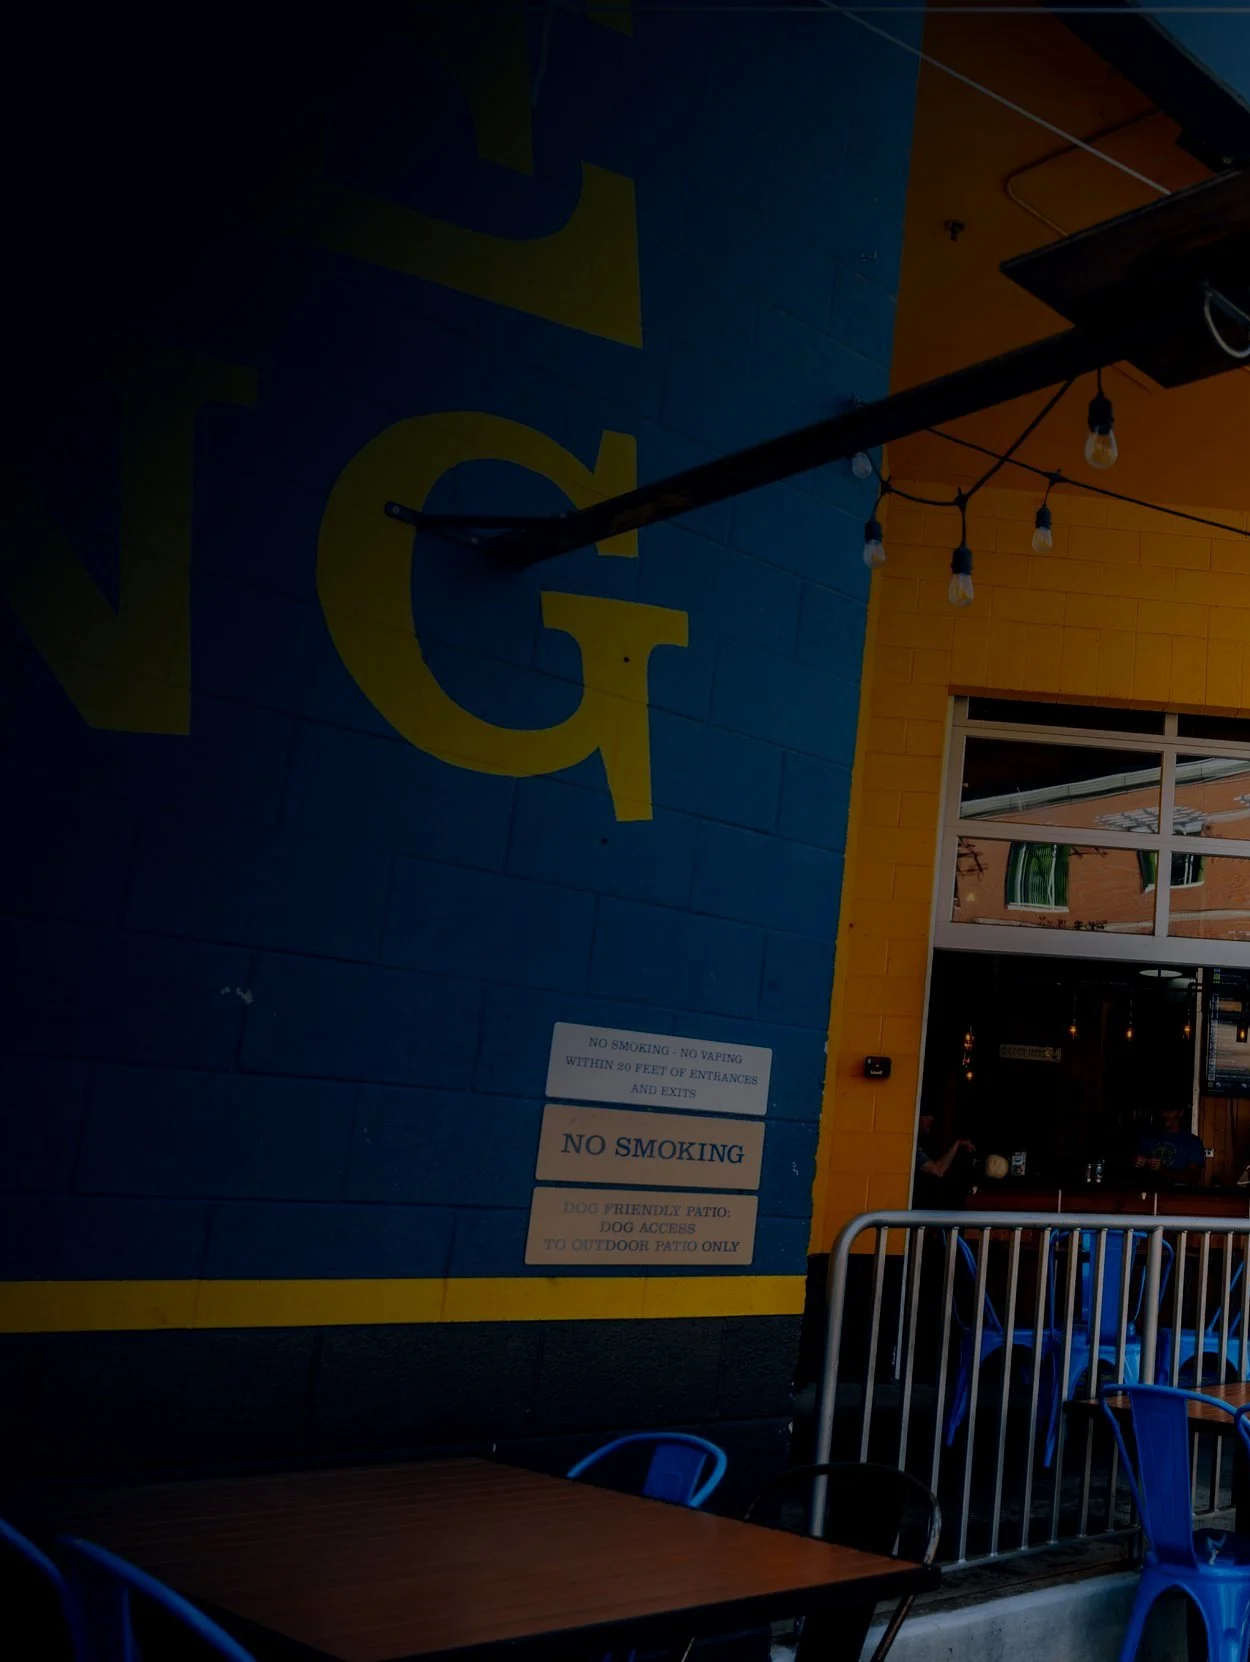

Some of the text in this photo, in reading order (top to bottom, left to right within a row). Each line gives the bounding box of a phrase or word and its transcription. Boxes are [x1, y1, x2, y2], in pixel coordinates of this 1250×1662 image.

[588, 1037, 608, 1049] NO
[611, 1039, 669, 1056] SMOKING
[680, 1047, 698, 1059] NO
[701, 1050, 743, 1065] VAPING
[565, 1056, 759, 1086] WITHIN 20 FEET OF ENTRANCES
[631, 1083, 697, 1098] AND EXITS
[561, 1133, 745, 1164] NO SMOKING
[563, 1202, 731, 1218] DOG FRIENDLY PATIO:
[600, 1221, 696, 1234] DOG ACCESS
[543, 1238, 740, 1253] TO OUTDOOR PATIO ONLY
